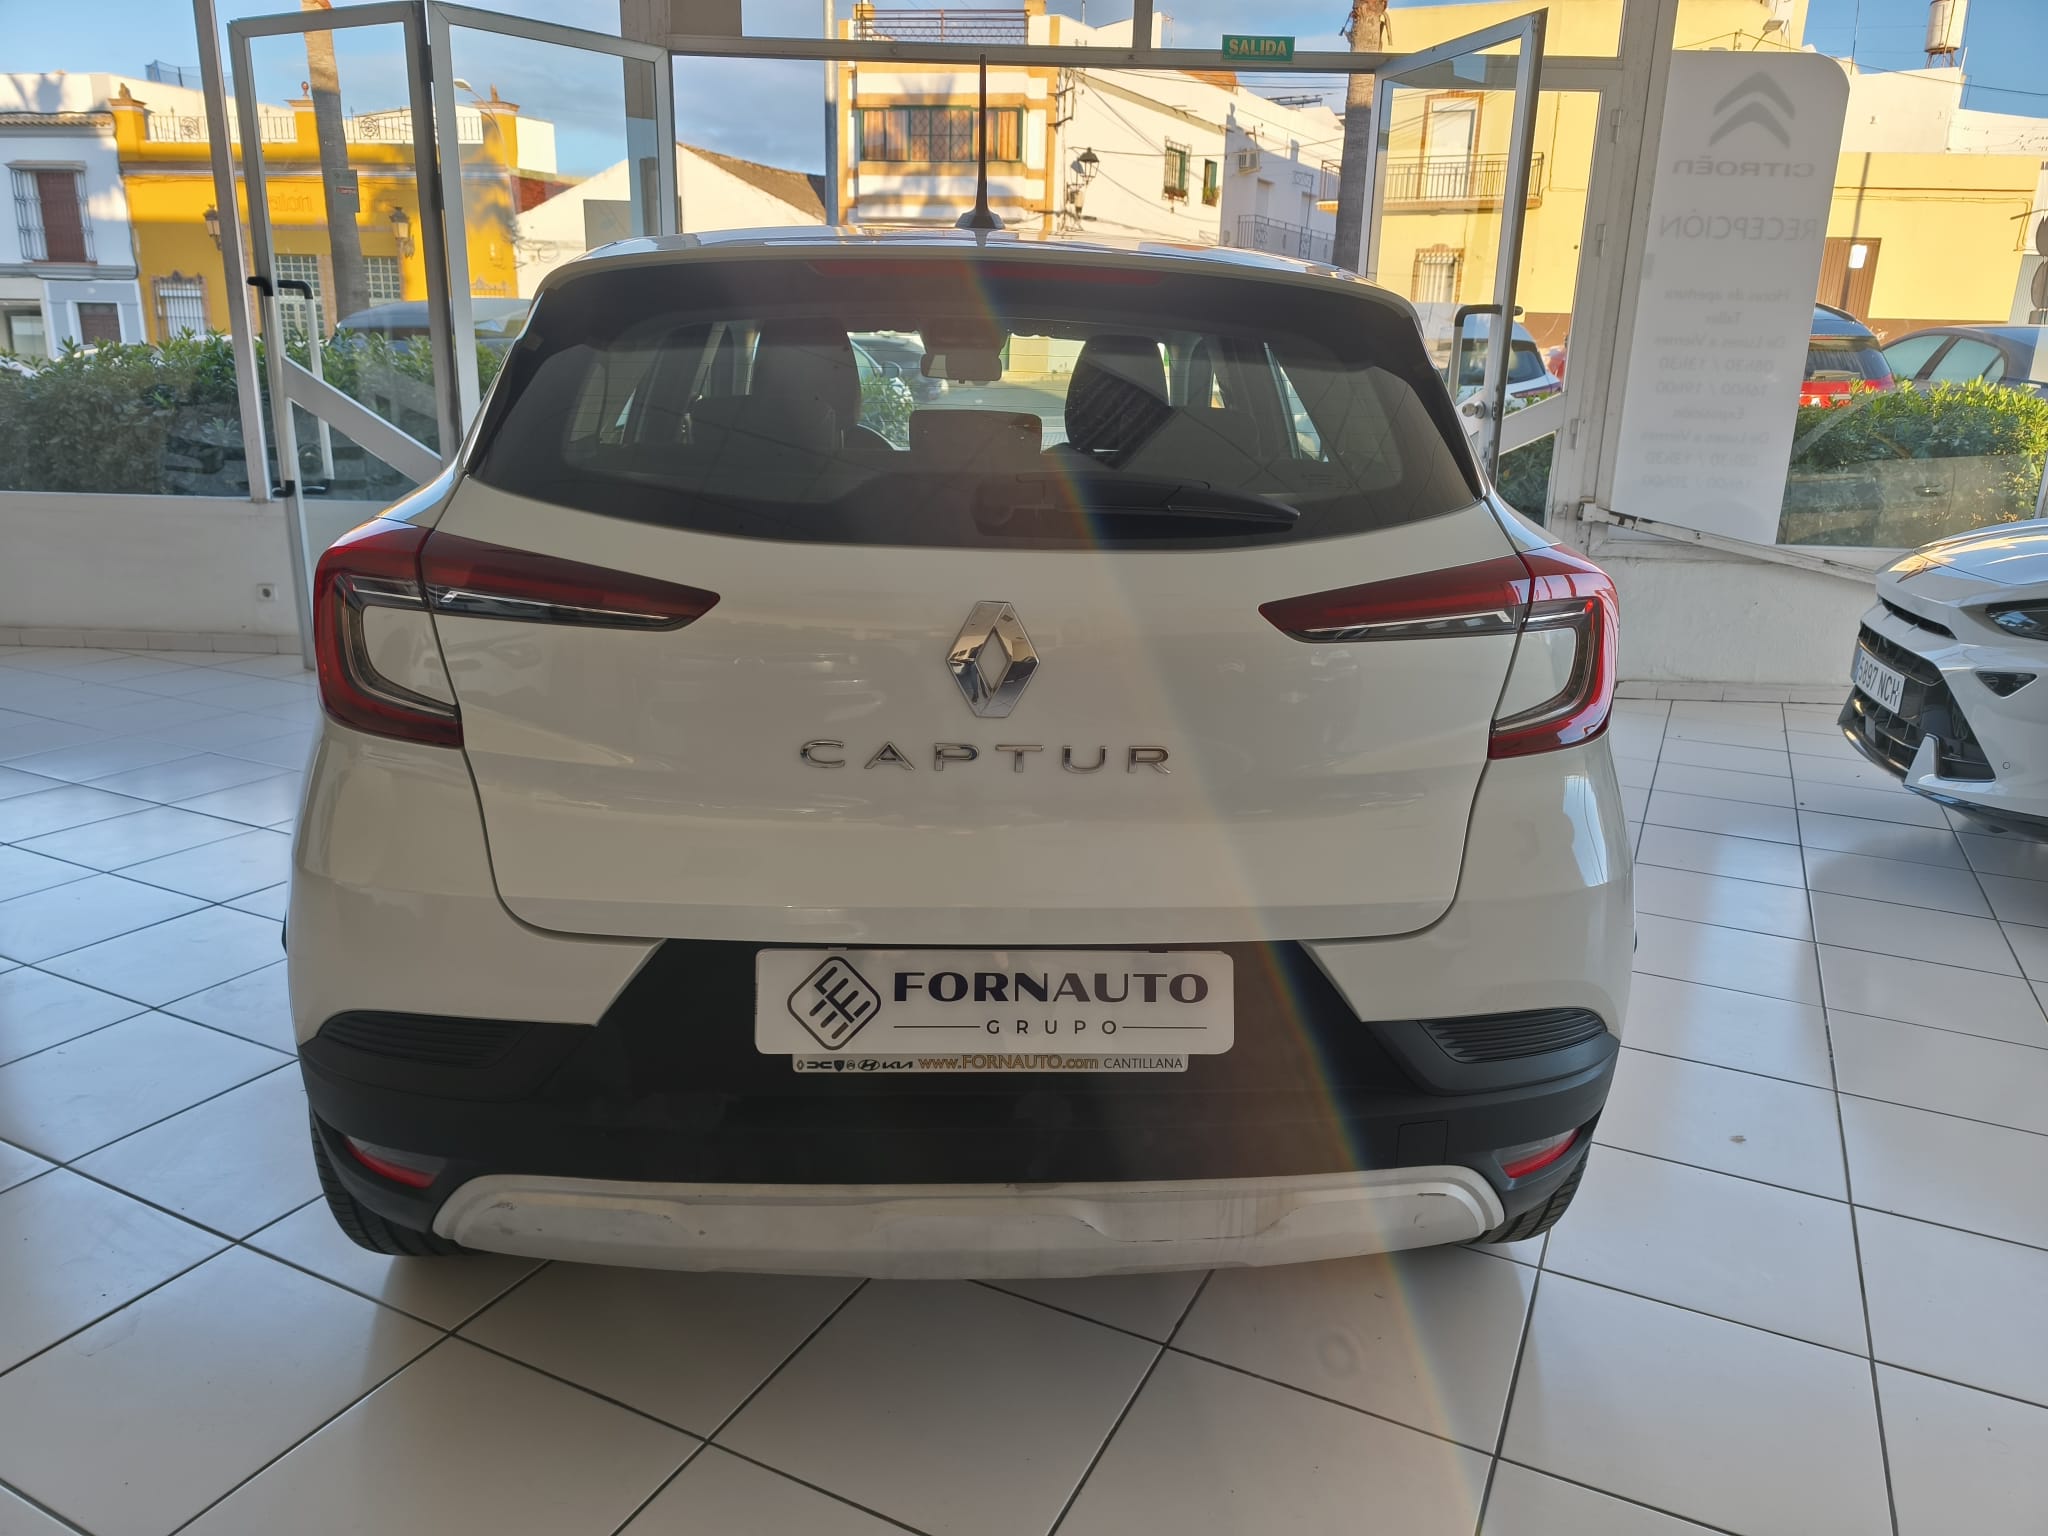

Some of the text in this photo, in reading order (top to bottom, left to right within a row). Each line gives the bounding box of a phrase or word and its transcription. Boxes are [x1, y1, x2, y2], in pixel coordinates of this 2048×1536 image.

[1229, 38, 1288, 56] SALIDA
[1858, 656, 1878, 691] 5897
[800, 739, 1172, 775] CAPTUR
[893, 971, 1209, 1004] FORNAUTO
[986, 1019, 1118, 1035] GRUPO
[918, 1054, 1099, 1070] www.FORNAUTO.com
[1103, 1057, 1184, 1069] CANTILLANA
